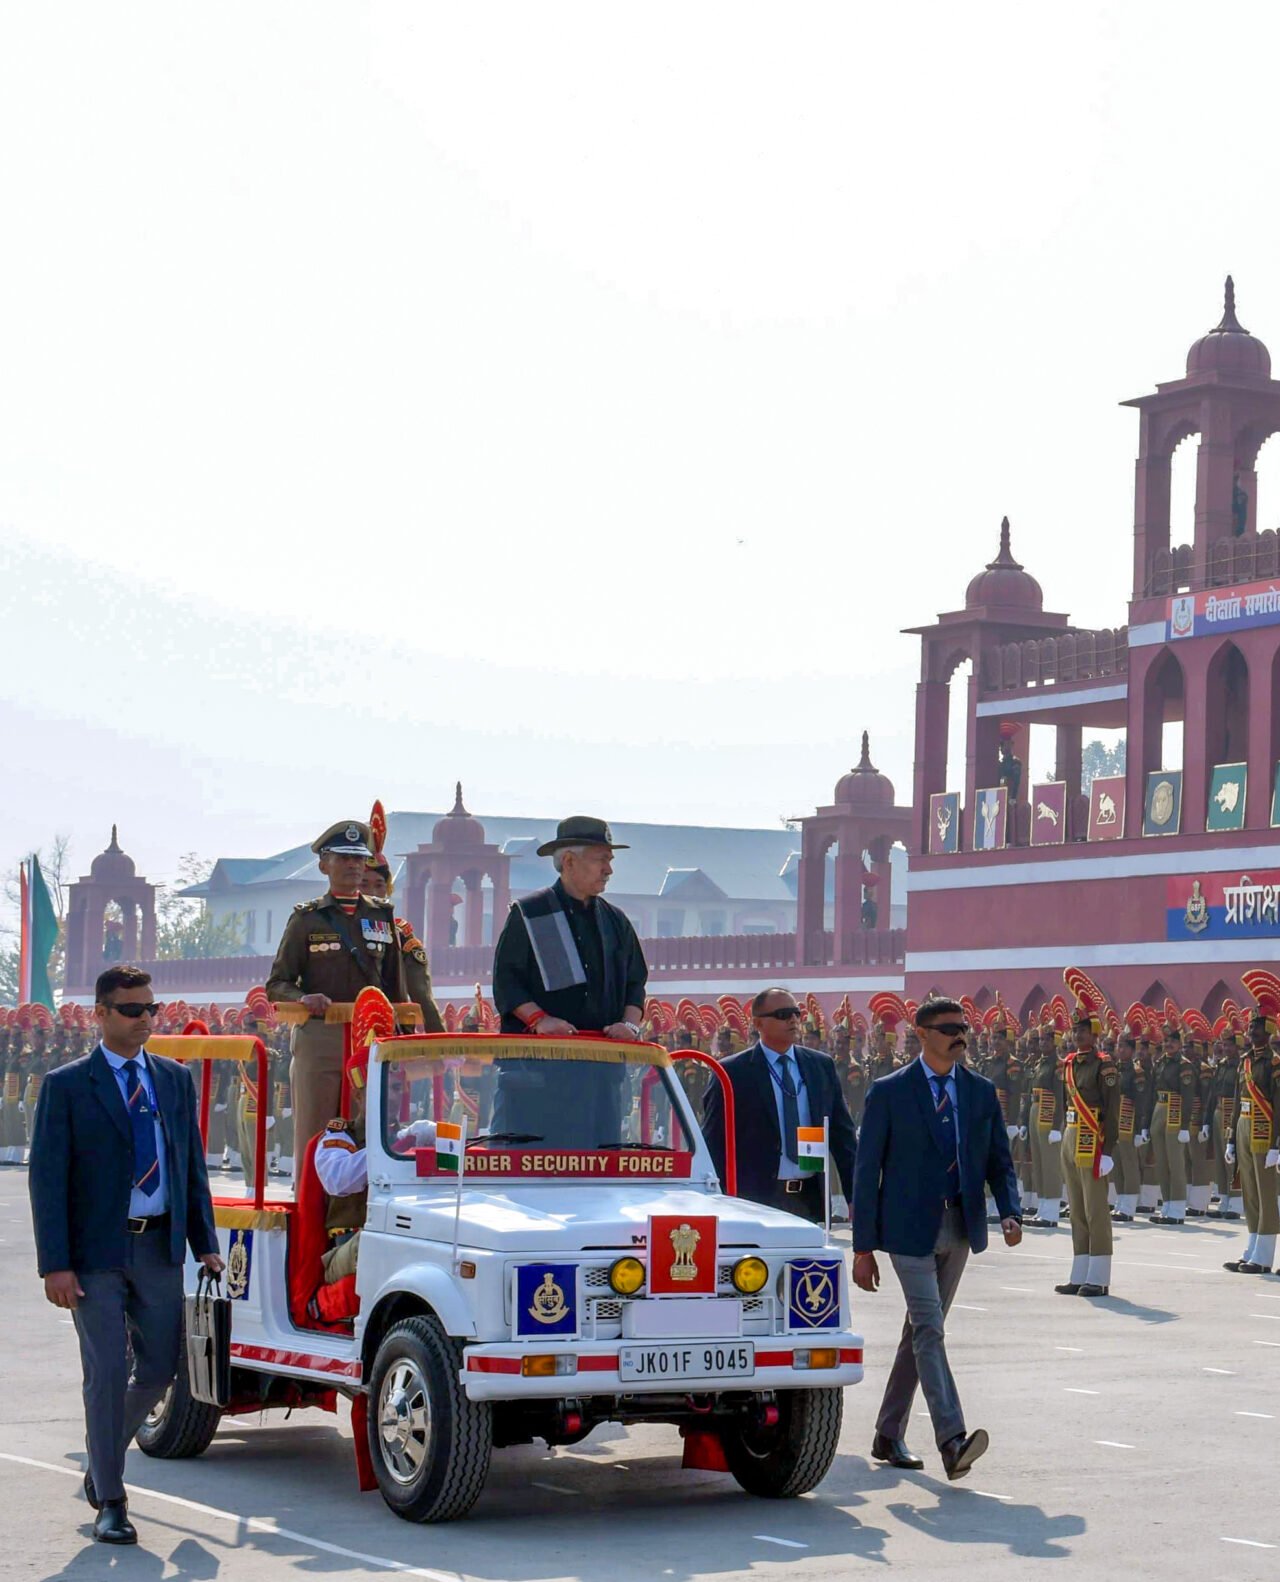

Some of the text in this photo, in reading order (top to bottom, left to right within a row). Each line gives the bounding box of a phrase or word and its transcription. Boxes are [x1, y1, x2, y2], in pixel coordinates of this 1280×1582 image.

[1205, 591, 1242, 622] दीक्षांत
[438, 1155, 674, 1172] RDER SECURITY FORCE
[636, 1349, 748, 1374] JK01F 9045
